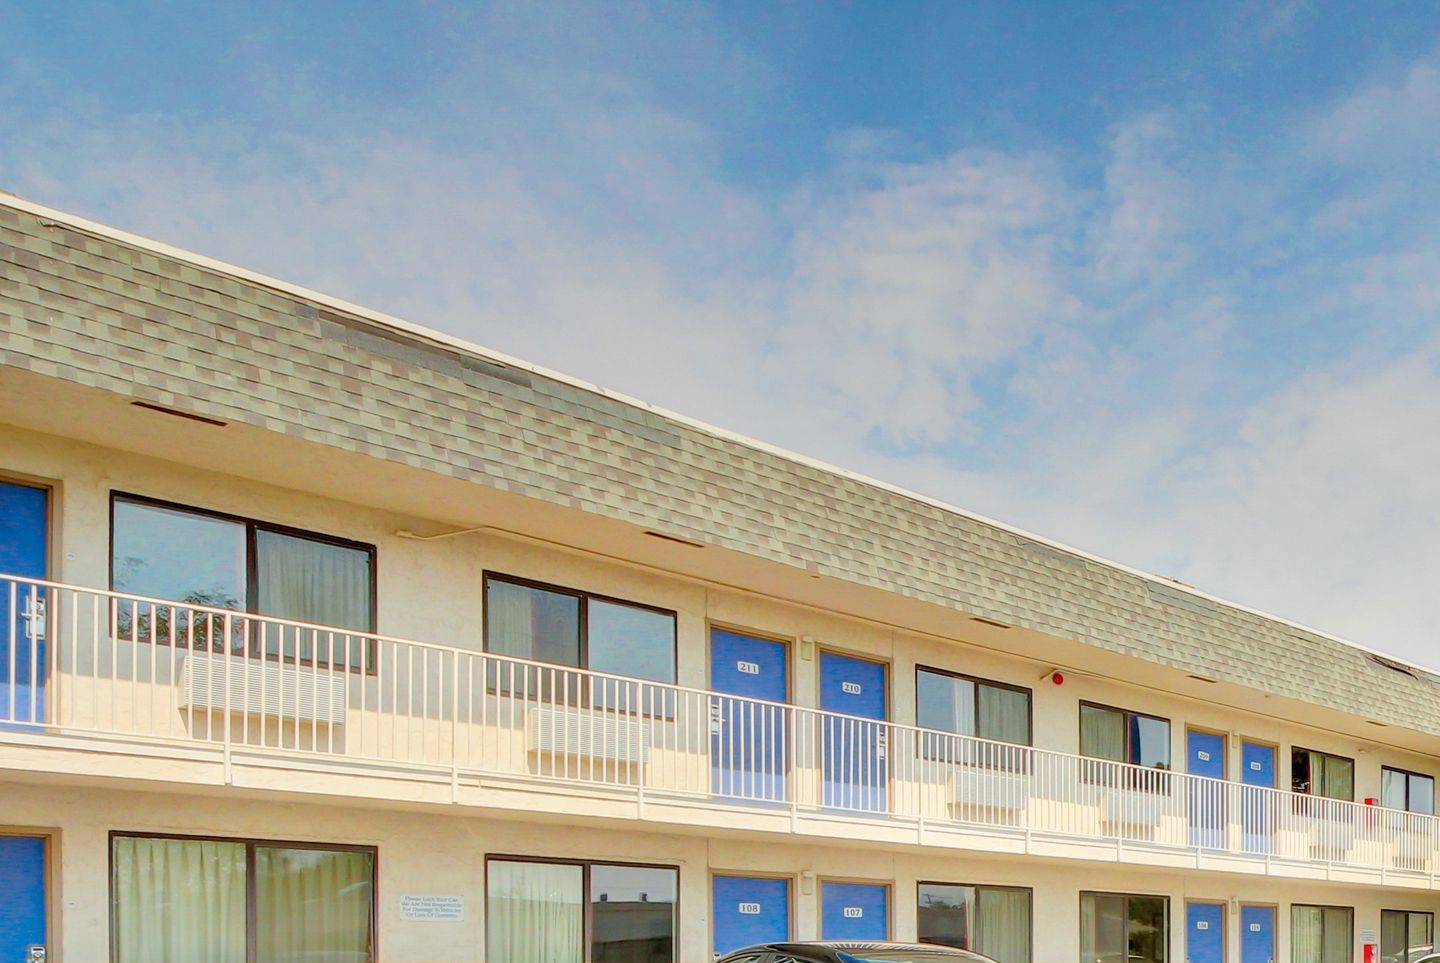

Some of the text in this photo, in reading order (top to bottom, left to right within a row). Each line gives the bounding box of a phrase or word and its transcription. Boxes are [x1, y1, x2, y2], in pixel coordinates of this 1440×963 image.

[739, 662, 757, 674] 211
[843, 683, 860, 694] 210
[741, 904, 758, 913] 108
[845, 908, 861, 917] 107
